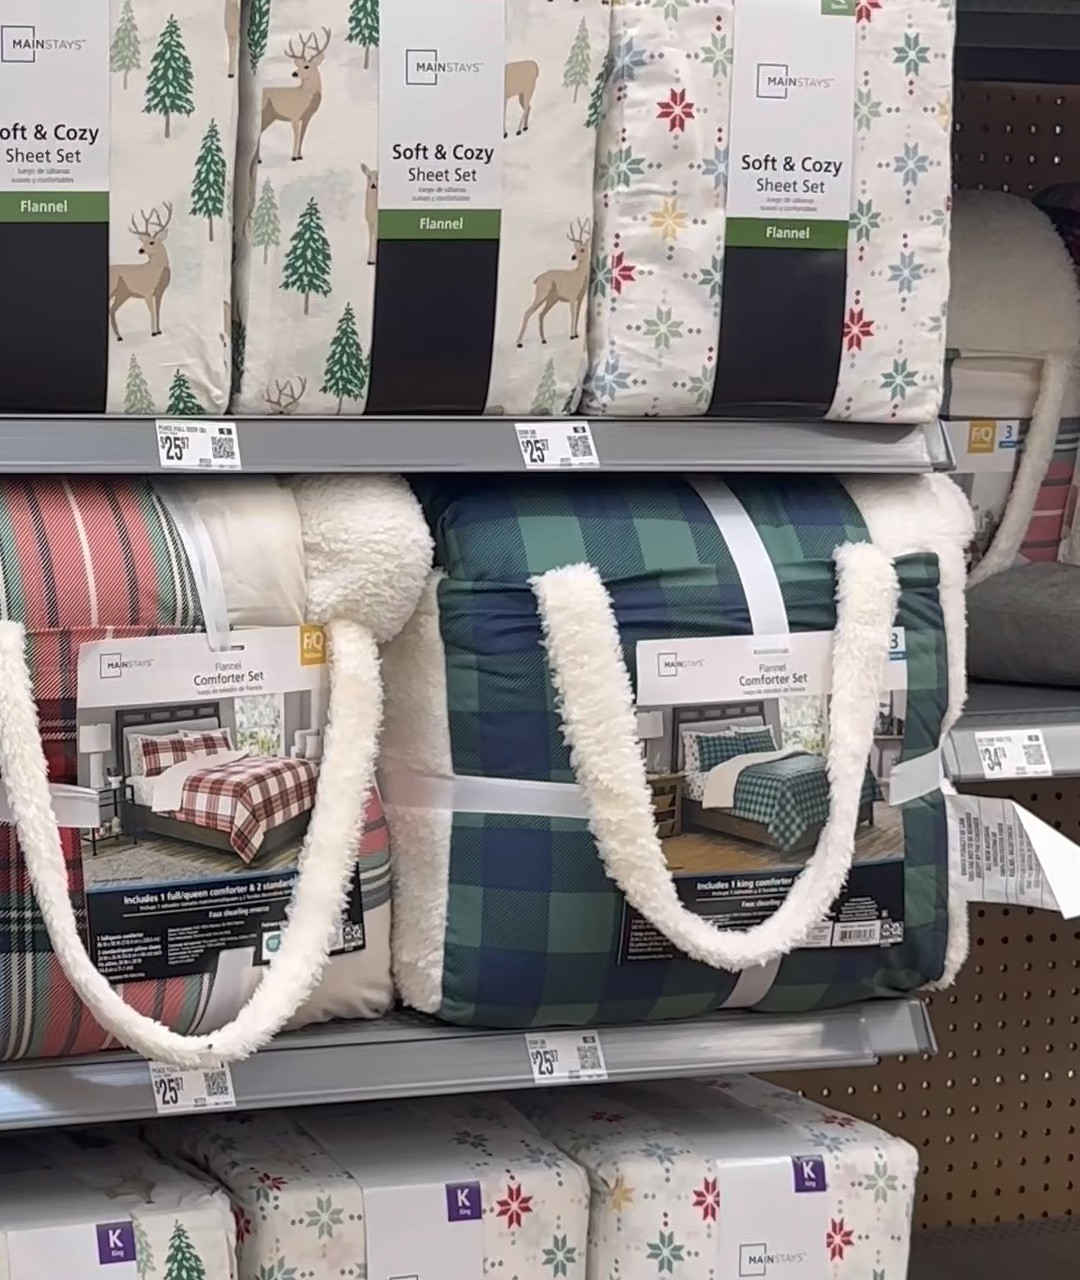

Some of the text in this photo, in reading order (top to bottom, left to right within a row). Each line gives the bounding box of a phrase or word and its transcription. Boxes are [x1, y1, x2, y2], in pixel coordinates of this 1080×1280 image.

[12, 39, 82, 50] MAINSTAYS
[416, 62, 480, 73] MAINSTAYS
[767, 76, 831, 88] MAINSTAYS
[34, 124, 47, 140] &
[54, 124, 99, 145] Cozy
[6, 148, 81, 163] Sheet Set
[392, 143, 494, 164] Soft & Cozy
[741, 154, 842, 177] Soft & Cozy
[408, 167, 477, 182] Sheet Set
[756, 177, 825, 194] Sheet Set
[20, 200, 68, 212] Flannel
[420, 217, 463, 229] Flannel
[766, 226, 810, 239] Flannel
[1005, 425, 1013, 440] 3
[215, 662, 242, 671] Flannel
[194, 671, 264, 686] Comforter Set
[739, 673, 808, 687] Comforter Set
[124, 894, 158, 905] Includes
[210, 885, 248, 897] comforter
[802, 1161, 816, 1179] K
[457, 1189, 471, 1207] K
[108, 1229, 123, 1248] K
